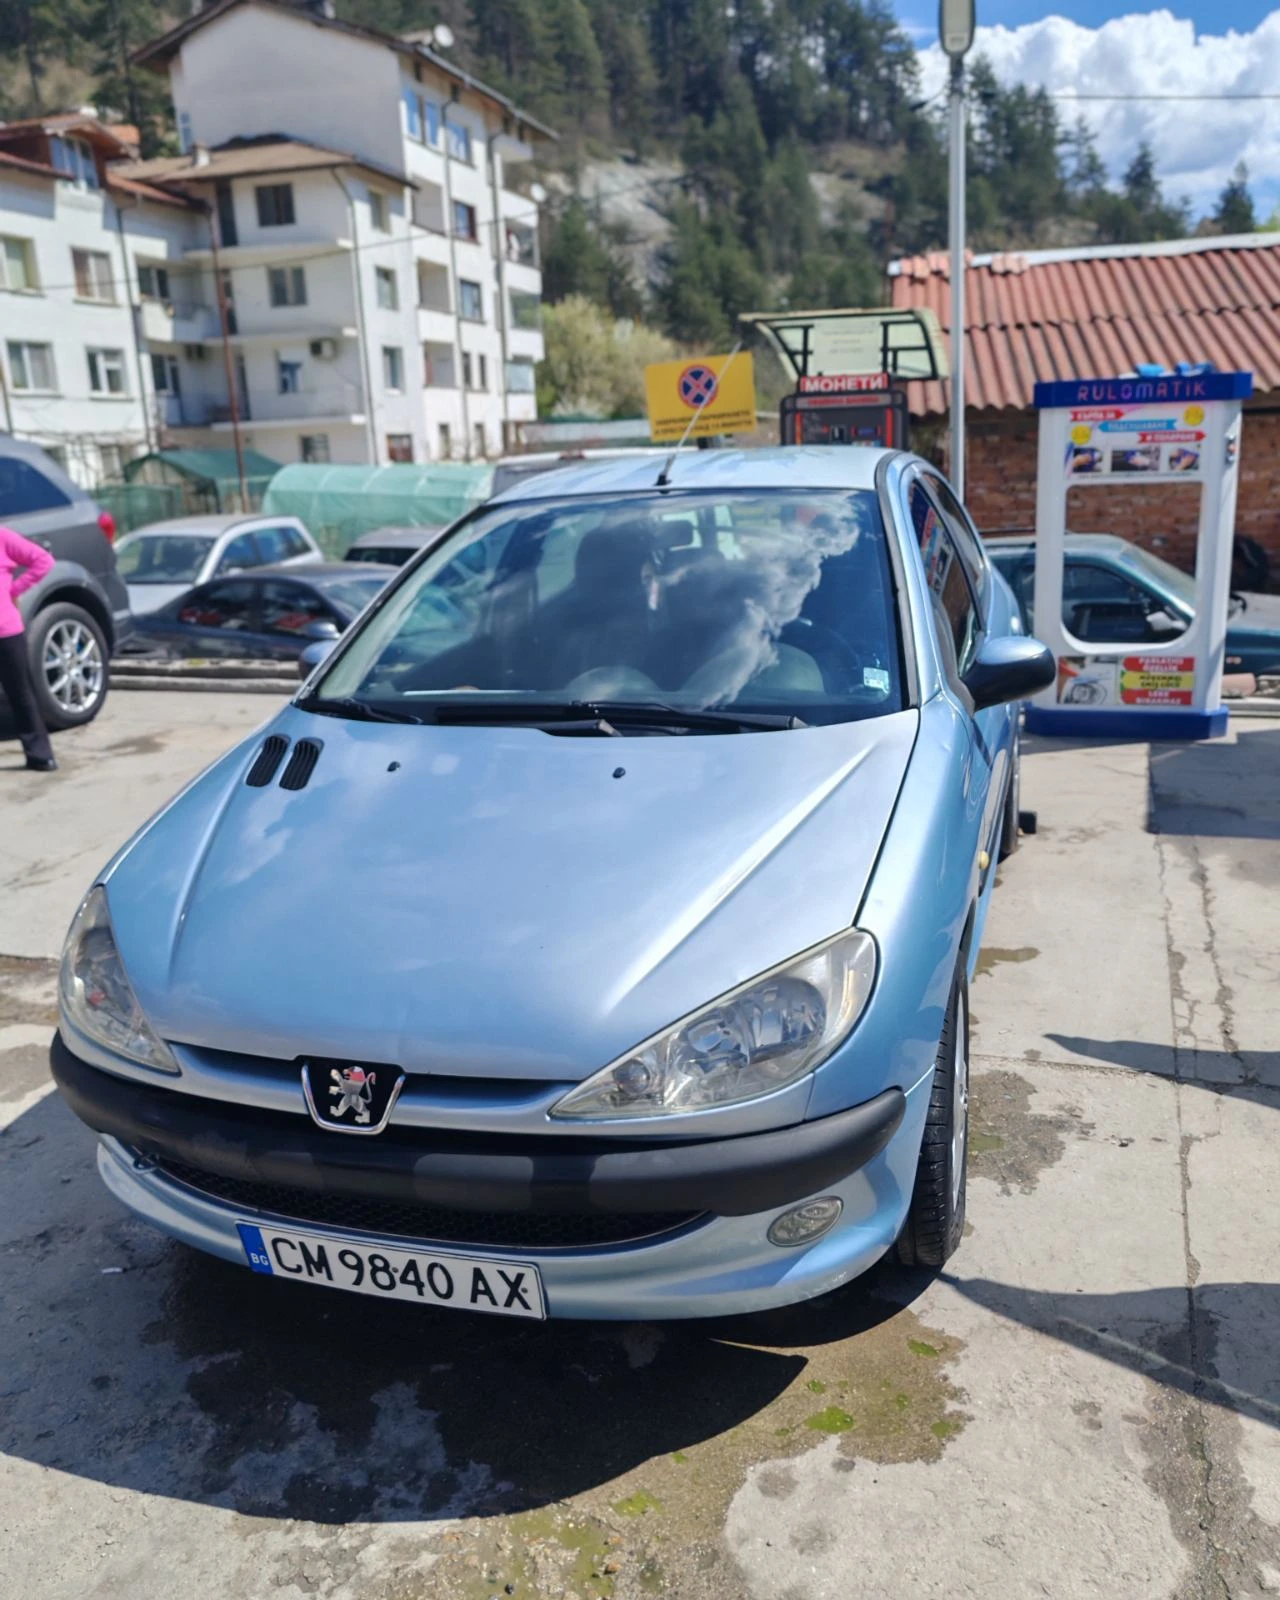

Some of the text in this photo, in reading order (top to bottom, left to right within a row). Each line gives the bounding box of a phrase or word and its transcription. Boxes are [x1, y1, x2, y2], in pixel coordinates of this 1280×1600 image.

[805, 376, 883, 392] МОНЕТИ
[1077, 381, 1206, 401] RULOMATIK
[250, 1252, 269, 1266] BG
[271, 1237, 532, 1310] CM 9840 AX
